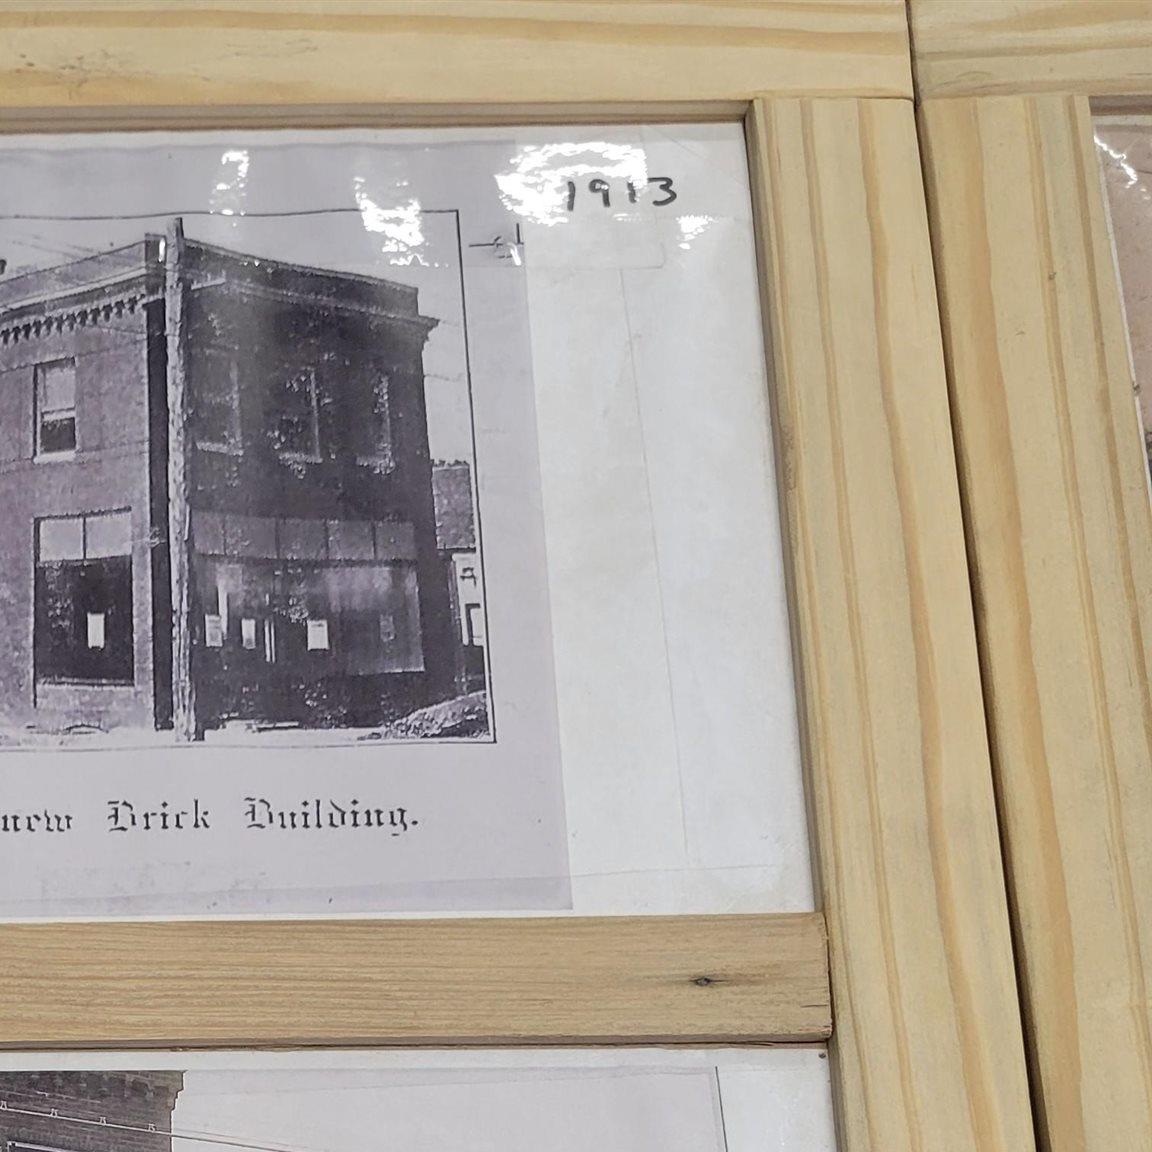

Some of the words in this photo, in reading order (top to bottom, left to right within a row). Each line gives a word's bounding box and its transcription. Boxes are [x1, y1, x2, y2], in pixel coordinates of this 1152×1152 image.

[567, 176, 677, 212] 1913
[1, 808, 74, 833] new
[107, 797, 211, 833] Brick
[244, 795, 420, 837] Building.
